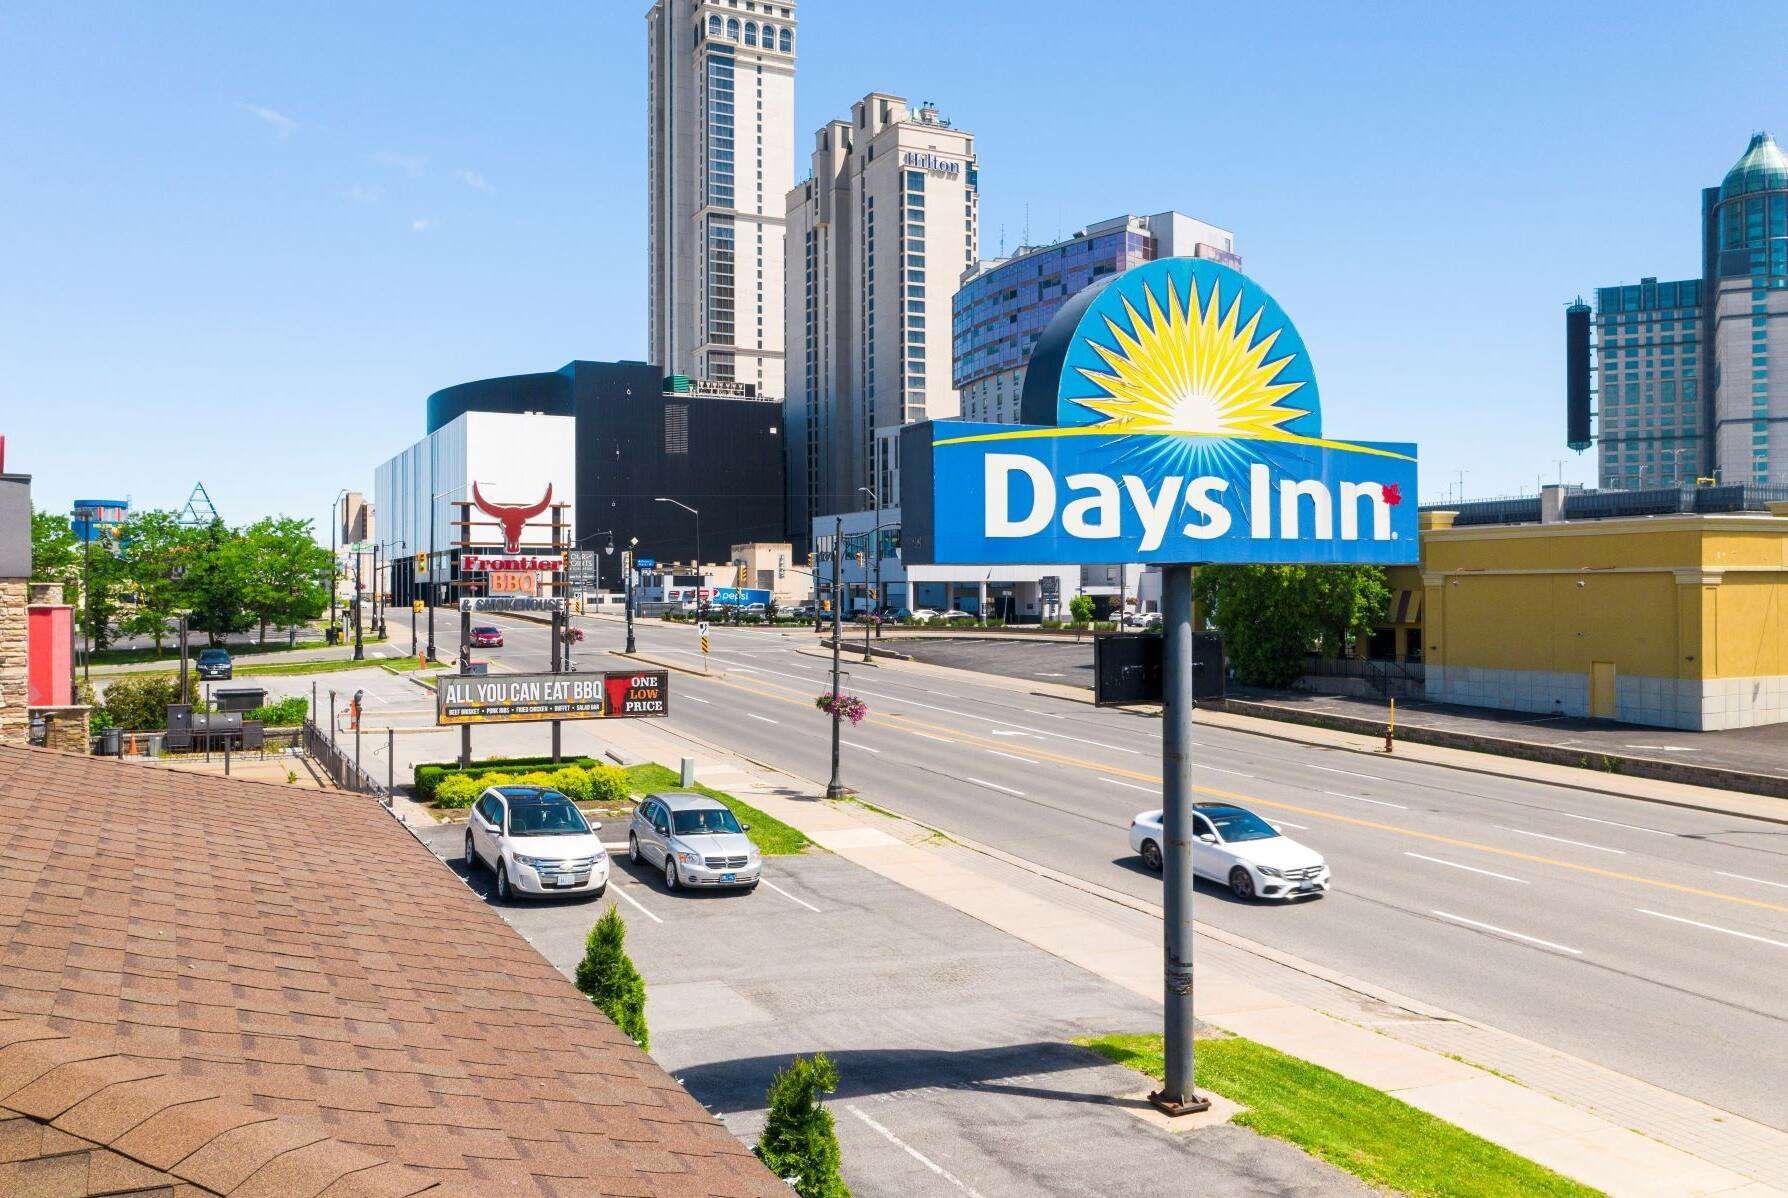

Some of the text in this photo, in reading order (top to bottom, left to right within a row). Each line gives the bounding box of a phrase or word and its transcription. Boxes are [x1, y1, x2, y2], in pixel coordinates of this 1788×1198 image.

[904, 151, 960, 173] Hilton
[983, 452, 1394, 552] Days Inn
[462, 555, 563, 570] Frontier
[491, 573, 536, 594] BBQ
[722, 591, 749, 603] pepsi
[462, 598, 564, 612] & SMOKEHOUSE
[631, 676, 658, 687] ONE
[446, 680, 602, 704] ALL YOU CAN EAT BBQ
[630, 689, 659, 700] LOW
[626, 701, 663, 712] PRICE
